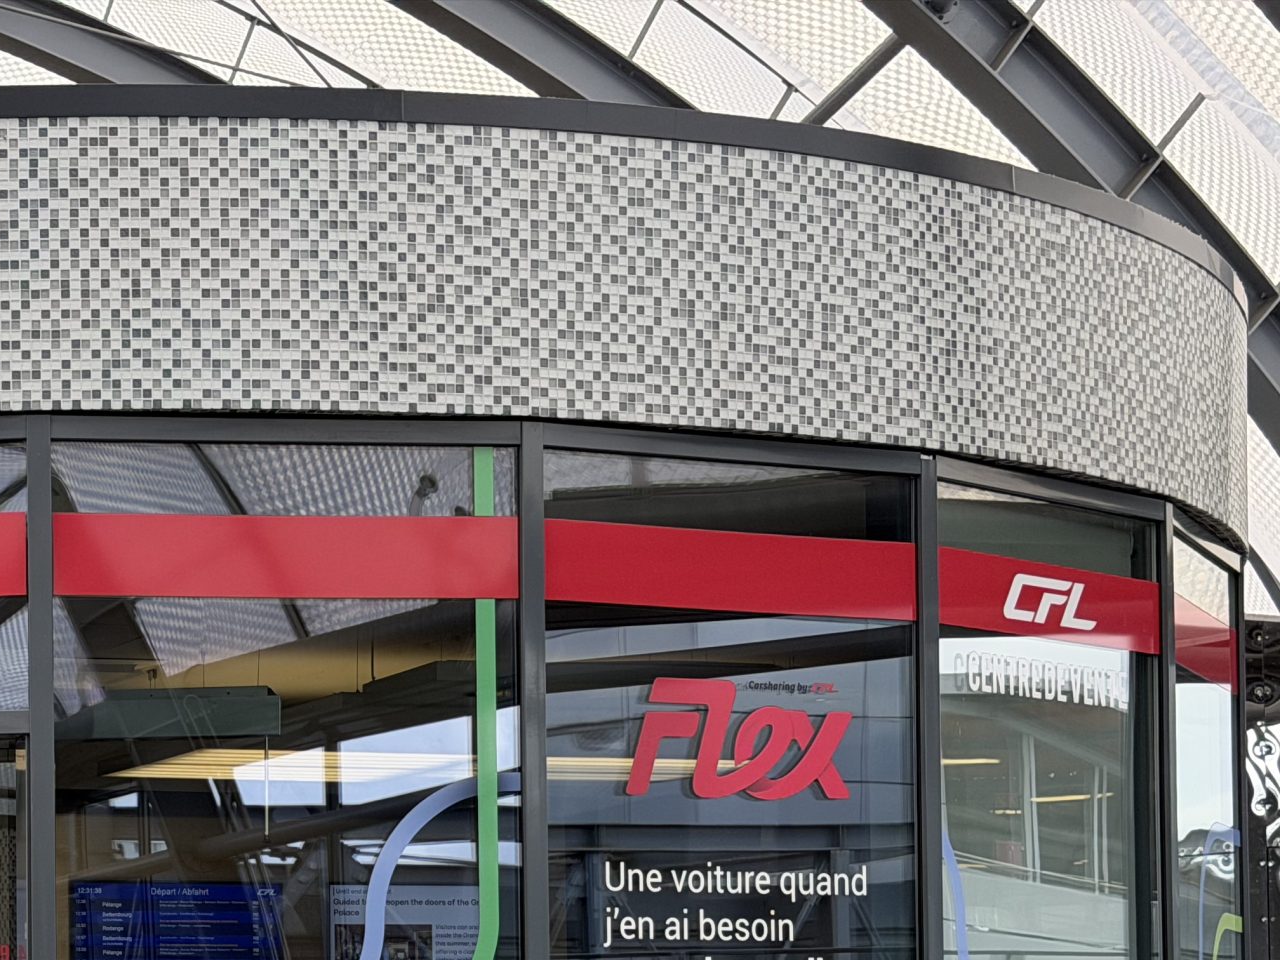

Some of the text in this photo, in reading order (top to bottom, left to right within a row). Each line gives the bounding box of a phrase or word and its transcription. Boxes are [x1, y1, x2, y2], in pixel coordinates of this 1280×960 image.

[1003, 573, 1098, 631] CFL
[748, 680, 796, 694] Carsharing
[797, 682, 808, 695] by
[968, 651, 1129, 710] CENTRE DE VENTE
[150, 888, 176, 896] Départ
[182, 888, 209, 896] Abfahrt
[604, 861, 868, 903] Une voiture quand
[603, 906, 794, 948] j'en ai besoin
